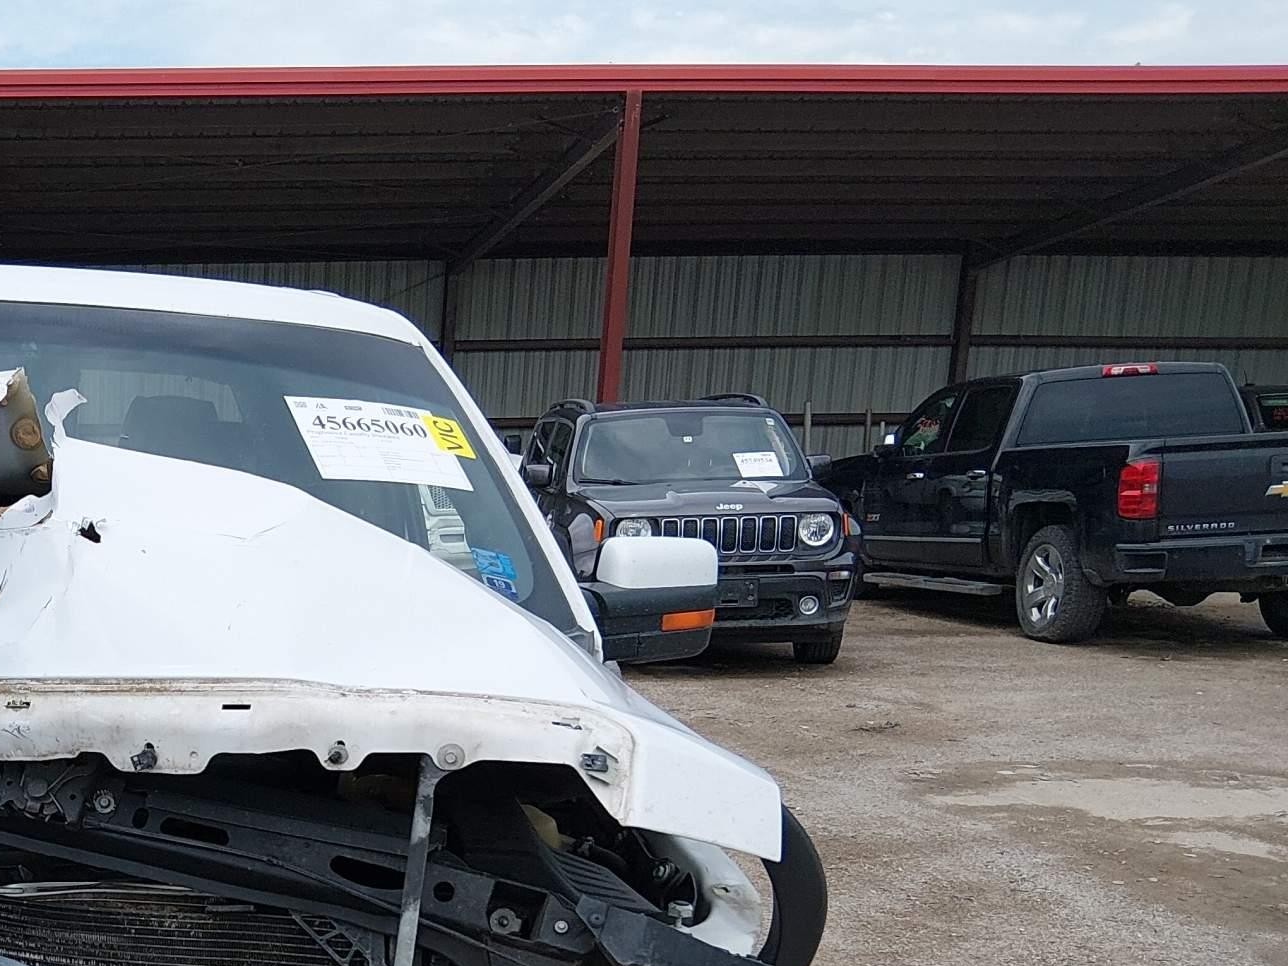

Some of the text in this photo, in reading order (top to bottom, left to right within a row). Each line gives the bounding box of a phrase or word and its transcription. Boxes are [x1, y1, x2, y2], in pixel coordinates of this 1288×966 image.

[312, 415, 428, 438] 45665060
[432, 420, 464, 450] VIC
[716, 503, 743, 511] Jeep
[1167, 522, 1235, 532] SILVERADO
